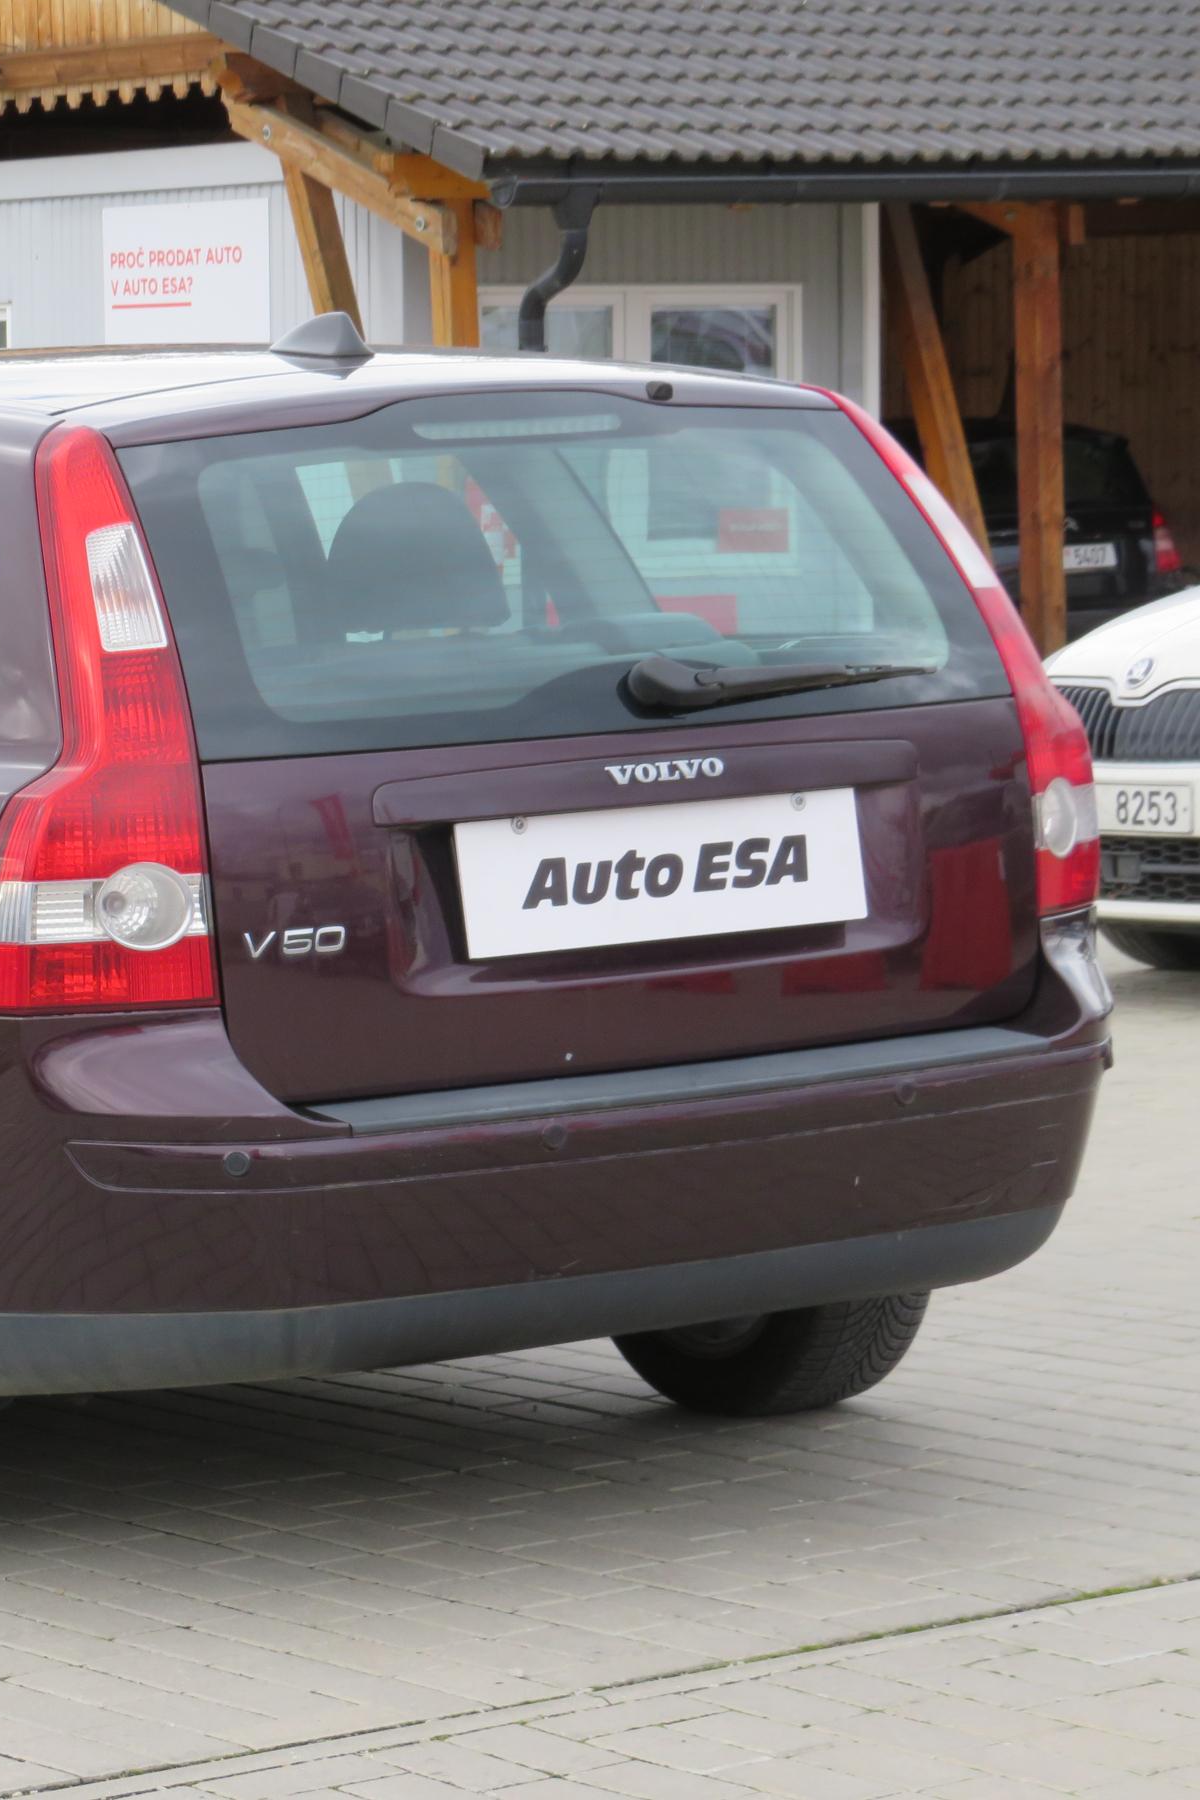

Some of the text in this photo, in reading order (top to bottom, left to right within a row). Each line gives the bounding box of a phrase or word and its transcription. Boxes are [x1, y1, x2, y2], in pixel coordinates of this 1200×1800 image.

[110, 246, 243, 269] PROČ PRODAT AUTO
[111, 277, 194, 296] V AUTO ESA?
[604, 757, 724, 785] VOLVO
[1116, 790, 1177, 826] 8253
[521, 834, 809, 910] Auto ESA
[243, 925, 346, 958] V50
